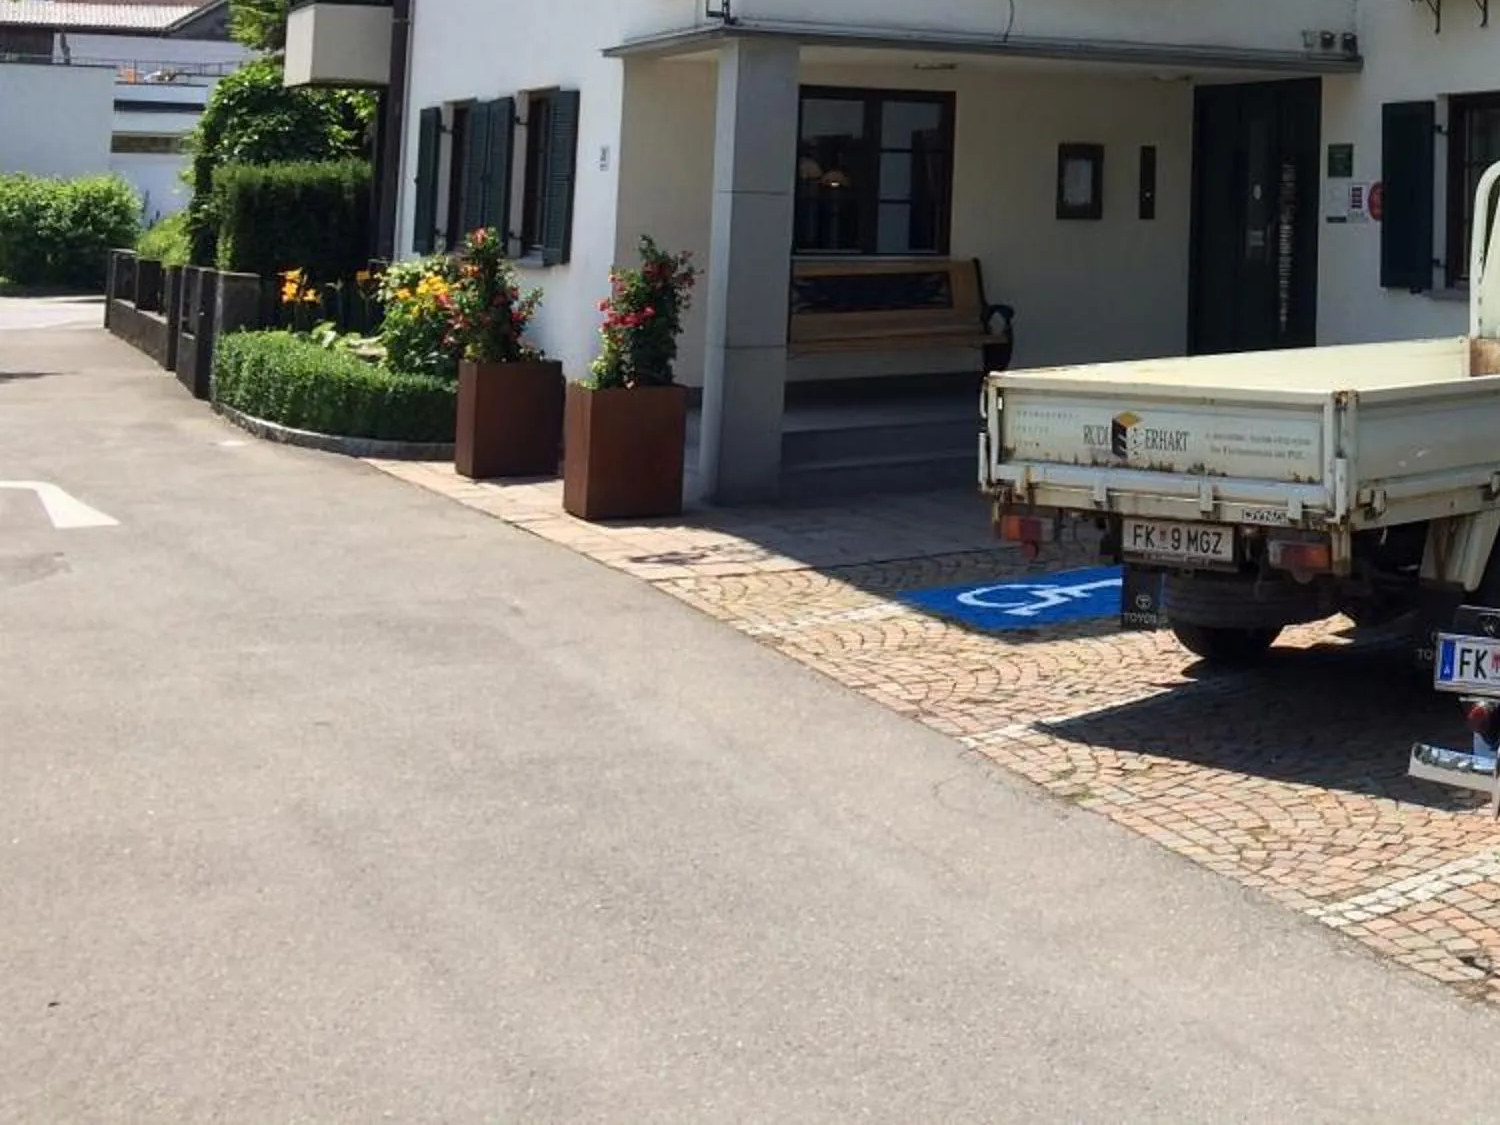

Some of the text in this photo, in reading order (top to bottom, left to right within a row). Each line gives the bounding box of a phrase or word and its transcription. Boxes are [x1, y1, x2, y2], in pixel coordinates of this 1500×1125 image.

[1082, 423, 1111, 447] RUDI
[1145, 428, 1190, 452] ERHART
[1132, 525, 1156, 548] FK
[1171, 527, 1182, 551] 9
[1460, 648, 1488, 679] FK
